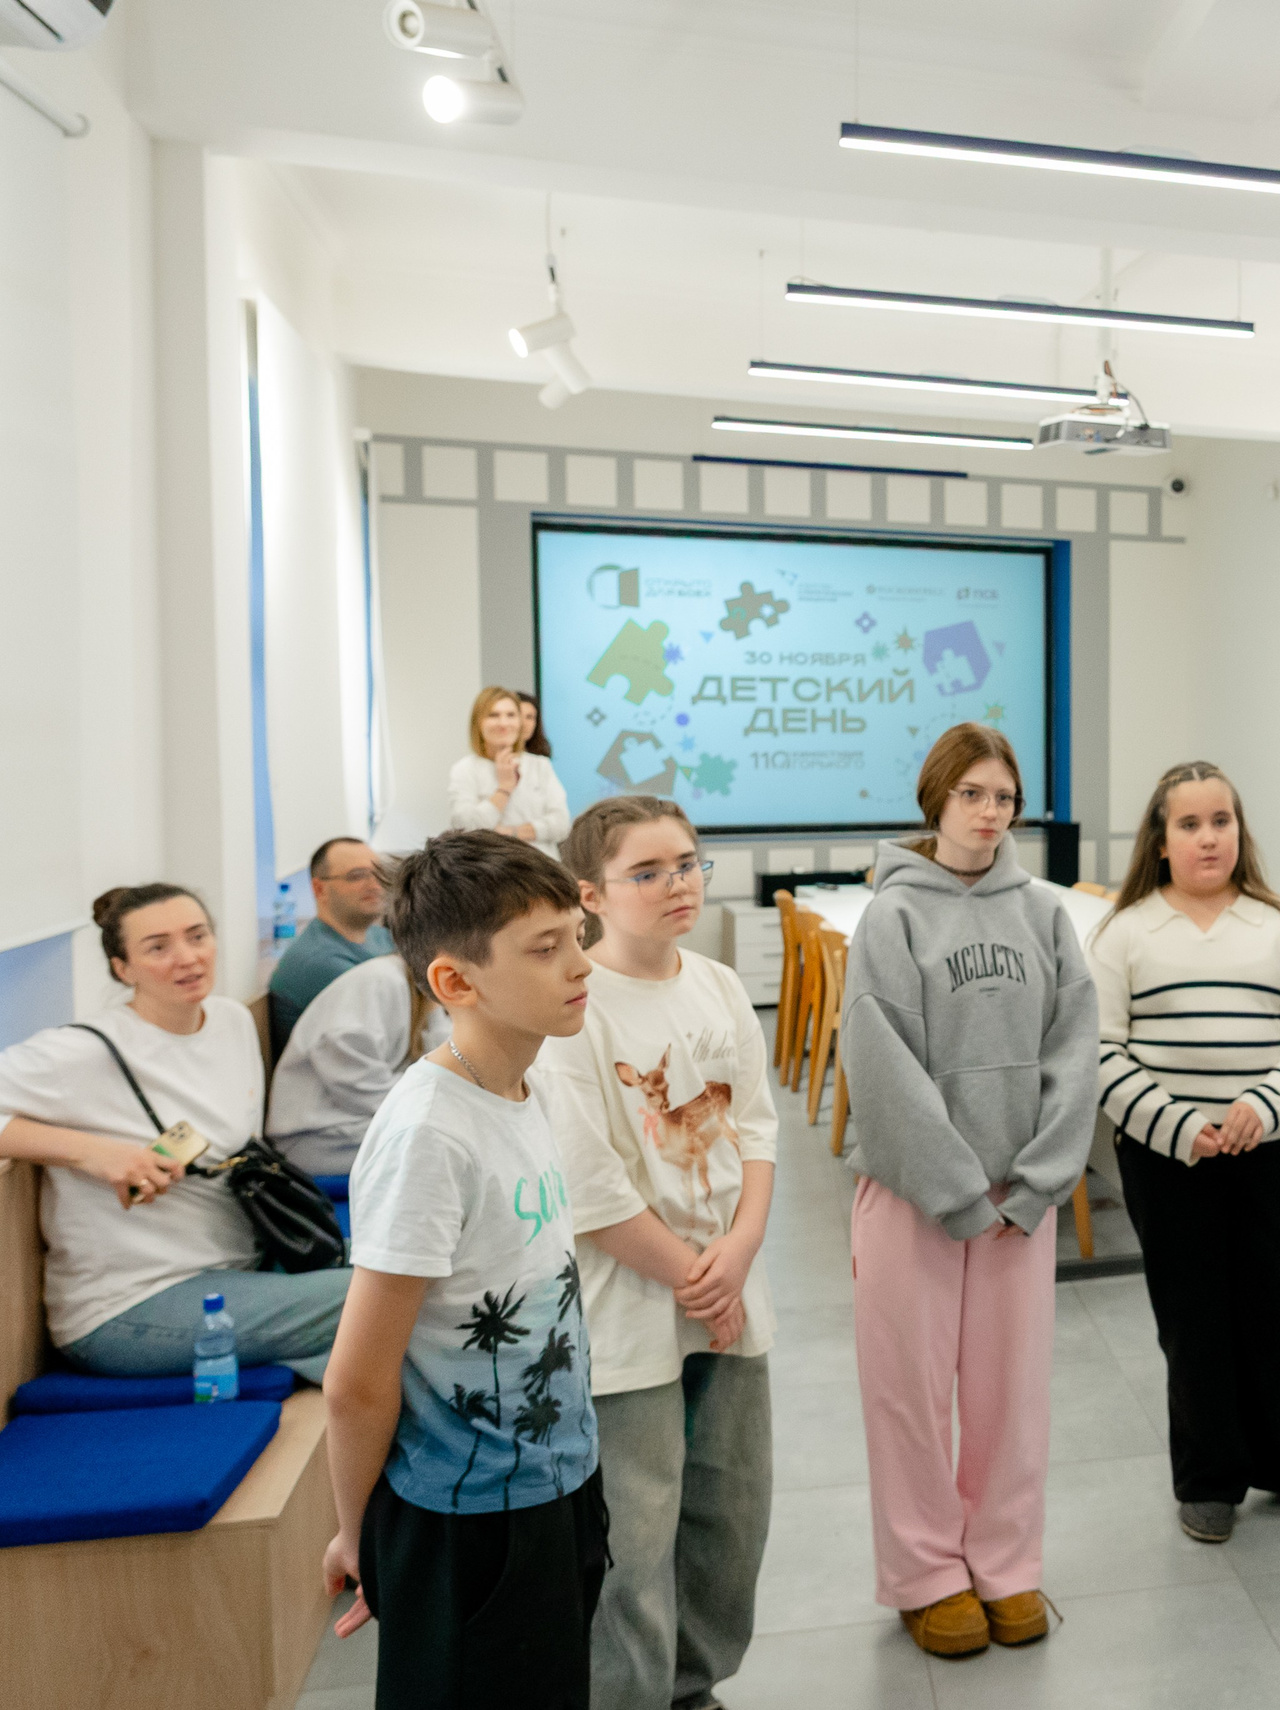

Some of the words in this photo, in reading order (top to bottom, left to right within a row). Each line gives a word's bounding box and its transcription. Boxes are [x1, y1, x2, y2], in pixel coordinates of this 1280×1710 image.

[744, 651, 772, 666] 30
[779, 651, 867, 667] НОЯБРЯ
[691, 668, 915, 705] ДЕТСКИЙ
[744, 707, 867, 737] ДЕНЬ
[946, 943, 1027, 993] MCLLCTN
